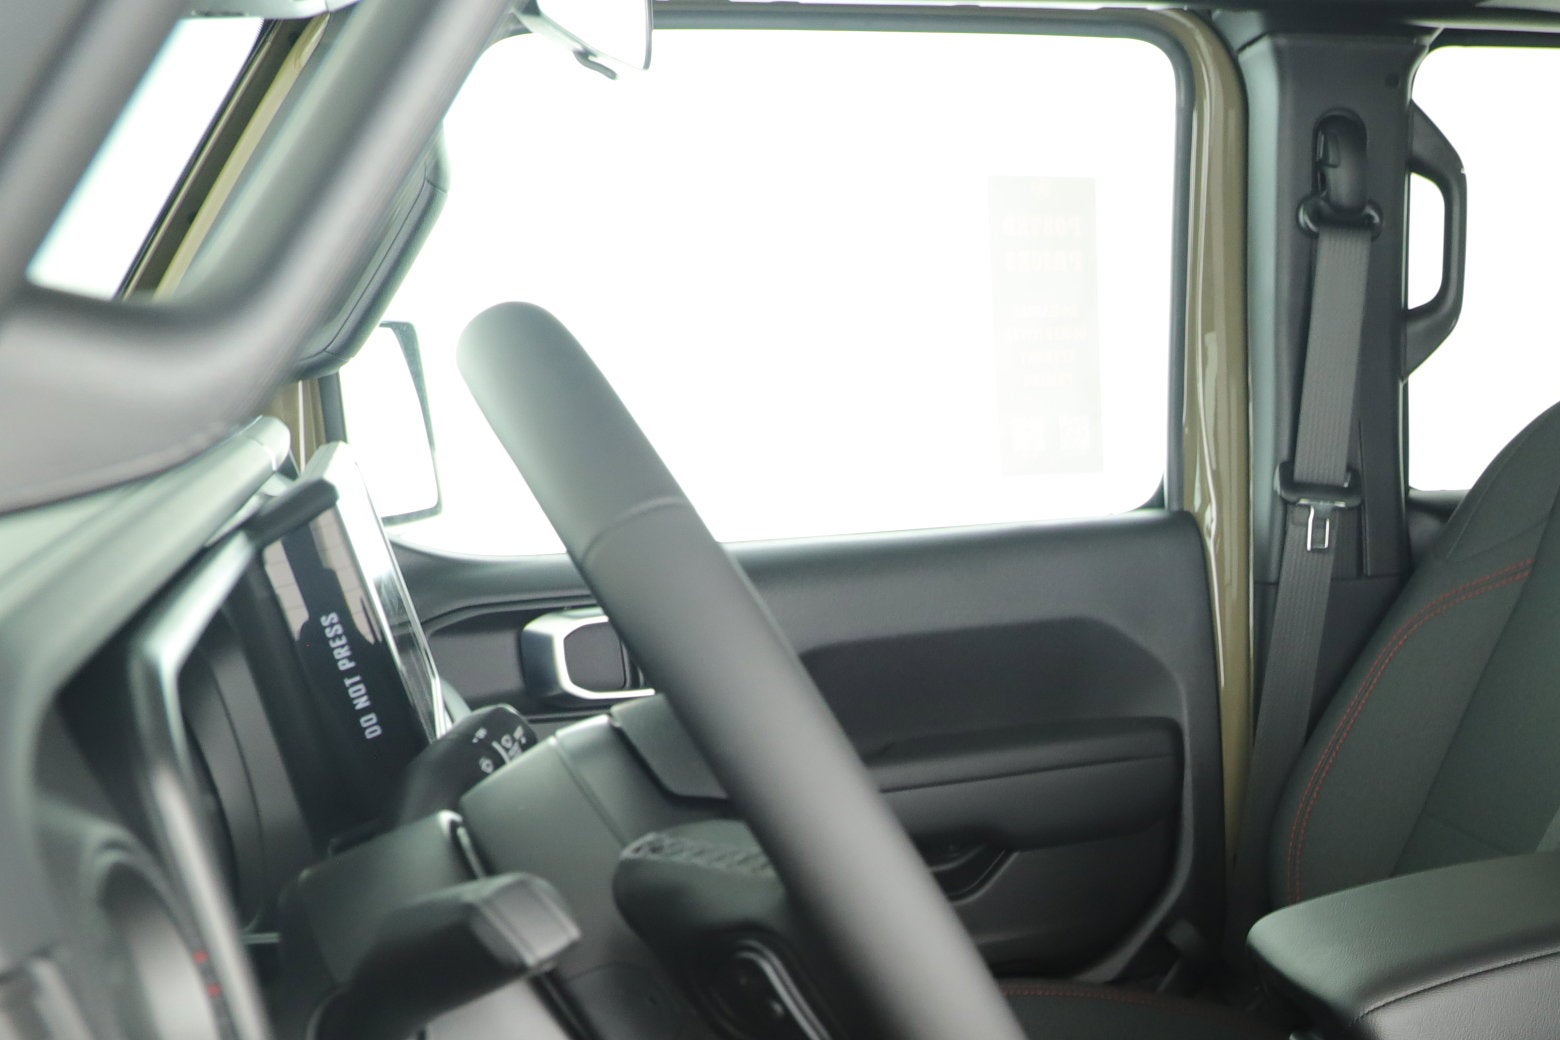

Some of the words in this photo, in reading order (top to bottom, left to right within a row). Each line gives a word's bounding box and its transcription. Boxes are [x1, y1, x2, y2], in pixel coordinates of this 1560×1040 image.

[320, 611, 356, 671] PRESS
[343, 675, 371, 711] NOT
[359, 712, 383, 740] DO
